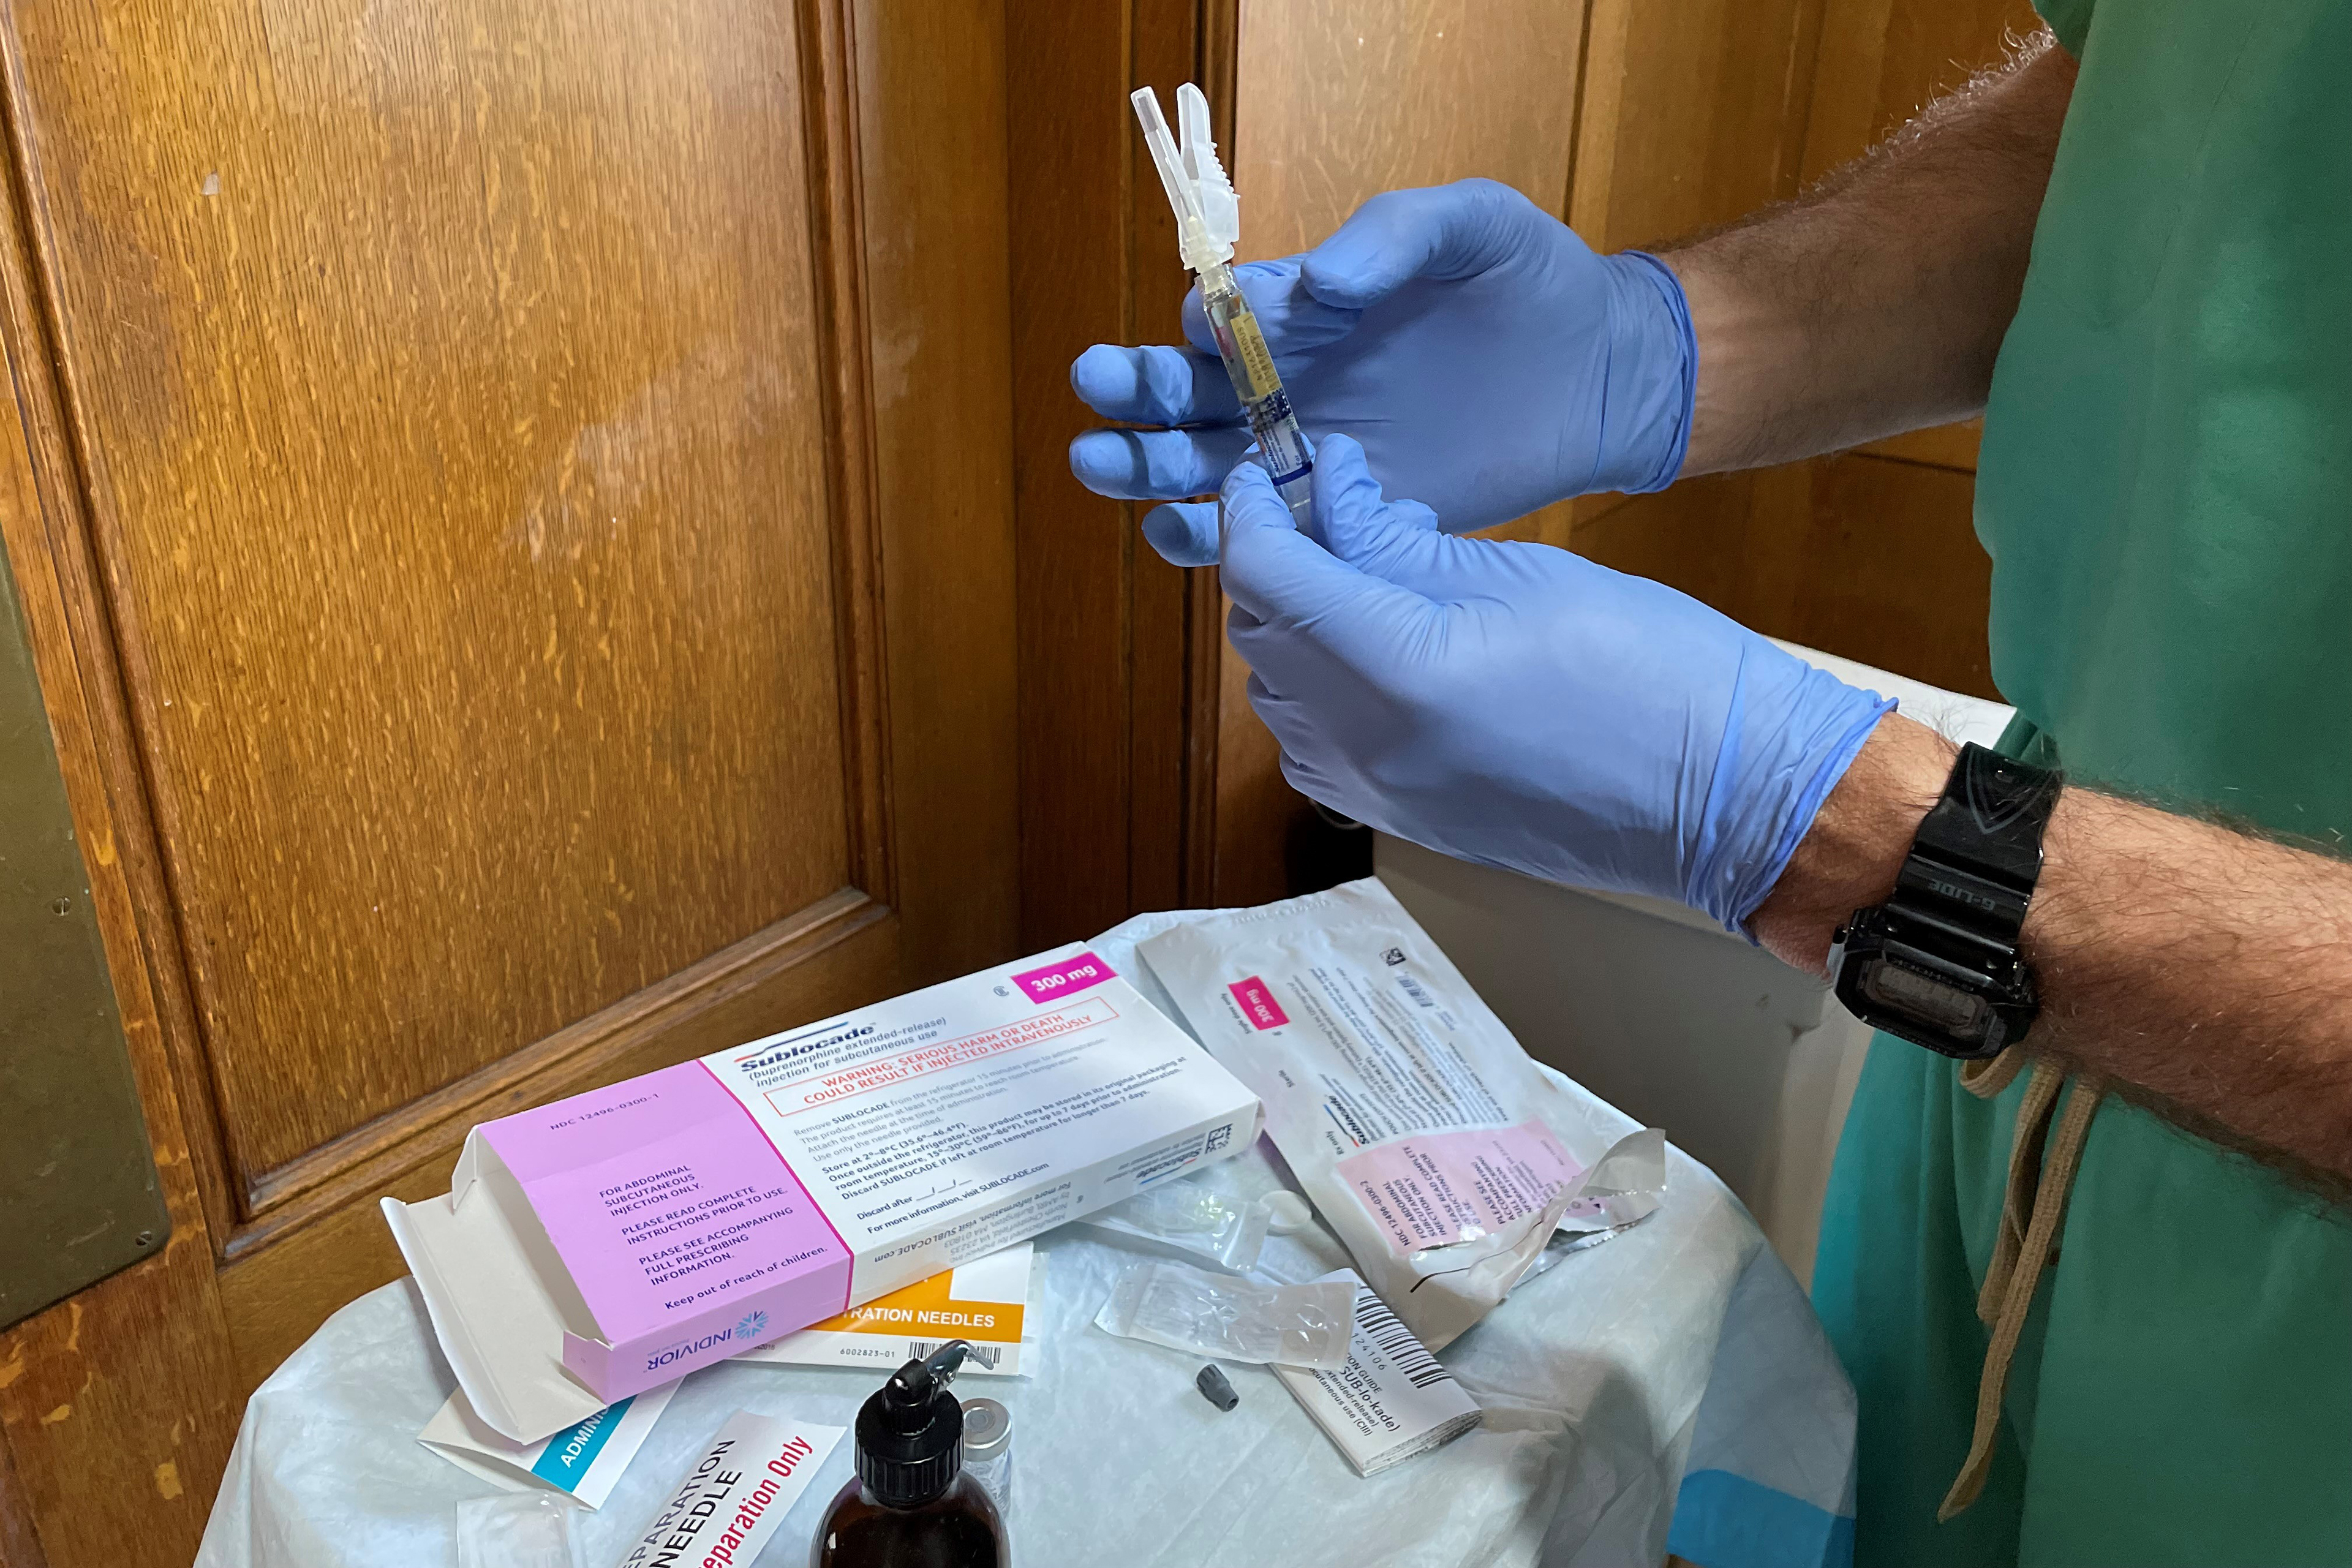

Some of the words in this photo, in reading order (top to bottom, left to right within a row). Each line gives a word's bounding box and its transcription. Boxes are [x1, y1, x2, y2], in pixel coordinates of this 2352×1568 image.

[1929, 878, 1996, 911] G-LIDE
[1030, 973, 1067, 992] 300
[1066, 964, 1098, 981] mg
[1246, 988, 1262, 1005] mg
[1253, 1004, 1275, 1022] 300
[741, 1027, 873, 1072] Sublocade
[757, 1067, 809, 1087] injection
[814, 1060, 829, 1069] for
[834, 1036, 914, 1064] subcutaneous
[918, 1031, 937, 1040] use
[804, 1084, 854, 1104] COULD
[858, 1068, 908, 1088] RESULT
[912, 1063, 923, 1072] IF
[927, 1043, 988, 1072] INJECTED
[989, 1016, 1091, 1055] INTRAVENOUSLY
[821, 1057, 892, 1091] WARNING:
[898, 1041, 957, 1069] SERIOUS
[959, 1034, 1000, 1052] HARM
[1000, 1028, 1021, 1038] OR
[1020, 1015, 1064, 1031] DEATH
[550, 1120, 575, 1130] NDC
[580, 1094, 658, 1120] 12496-0300-1
[794, 1121, 831, 1136] Remove
[832, 1102, 889, 1124] SUBLOCADE
[820, 1123, 856, 1140] product
[834, 1146, 853, 1155] only
[871, 1130, 902, 1143] needle
[857, 1125, 888, 1137] needle
[829, 1170, 854, 1182] Once
[857, 1158, 892, 1172] outside
[968, 1126, 987, 1134] this
[988, 1114, 1023, 1129] product
[842, 1182, 879, 1199] Discard
[880, 1161, 939, 1186] SUBLOCADE
[948, 1153, 966, 1162] left
[979, 1141, 1003, 1152] room
[1003, 1122, 1058, 1143] temperature
[599, 1186, 622, 1197] FOR
[625, 1166, 691, 1190] ABDOMINAL
[822, 1162, 850, 1174] Store
[835, 1178, 862, 1190] room
[605, 1174, 695, 1207] SUBCUTANEOUS
[611, 1193, 668, 1216] INJECTION
[671, 1183, 703, 1197] ONLY.
[867, 1225, 883, 1234] For
[884, 1216, 908, 1227] more
[962, 1189, 980, 1198] visit
[979, 1163, 1049, 1192] SUBLOCADE.com
[1383, 1182, 1416, 1221] ABDOMINAL
[622, 1216, 665, 1235] PLEASE
[665, 1207, 695, 1220] READ
[698, 1186, 755, 1209] COMPLETE
[627, 1213, 710, 1245] INSTRUCTIONS
[712, 1201, 745, 1216] PRIOR
[746, 1196, 761, 1204] TO
[763, 1188, 788, 1199] USE.
[857, 1203, 891, 1219] Discard
[892, 1197, 912, 1207] after
[1484, 1196, 1506, 1224] PLEASE
[639, 1245, 682, 1265] PLEASE
[684, 1238, 705, 1250] SEE
[707, 1207, 793, 1242] ACCOMPANYING
[875, 1227, 956, 1262] SUBLOCADE.com
[1395, 1229, 1411, 1246] NDC
[1412, 1223, 1427, 1238] FOR
[645, 1261, 674, 1275] FULL
[676, 1234, 748, 1264] PRESCRIBING
[651, 1253, 734, 1285] INFORMATION.
[665, 1296, 694, 1309] Keep
[697, 1287, 717, 1297] out
[720, 1280, 730, 1289] of
[734, 1269, 764, 1284] reach
[767, 1262, 777, 1272] of
[781, 1248, 827, 1267] children.
[917, 1309, 995, 1328] NEEDLES
[647, 1329, 731, 1370] INDIVIOR
[840, 1348, 895, 1358] 6002823-01
[1358, 1369, 1383, 1395] GUIDE
[1340, 1366, 1401, 1432] SUB-lo-kade)
[1342, 1404, 1357, 1420] use
[698, 1479, 781, 1568] eparation
[767, 1436, 813, 1477] Only
[649, 1470, 743, 1568] NEEDLE
